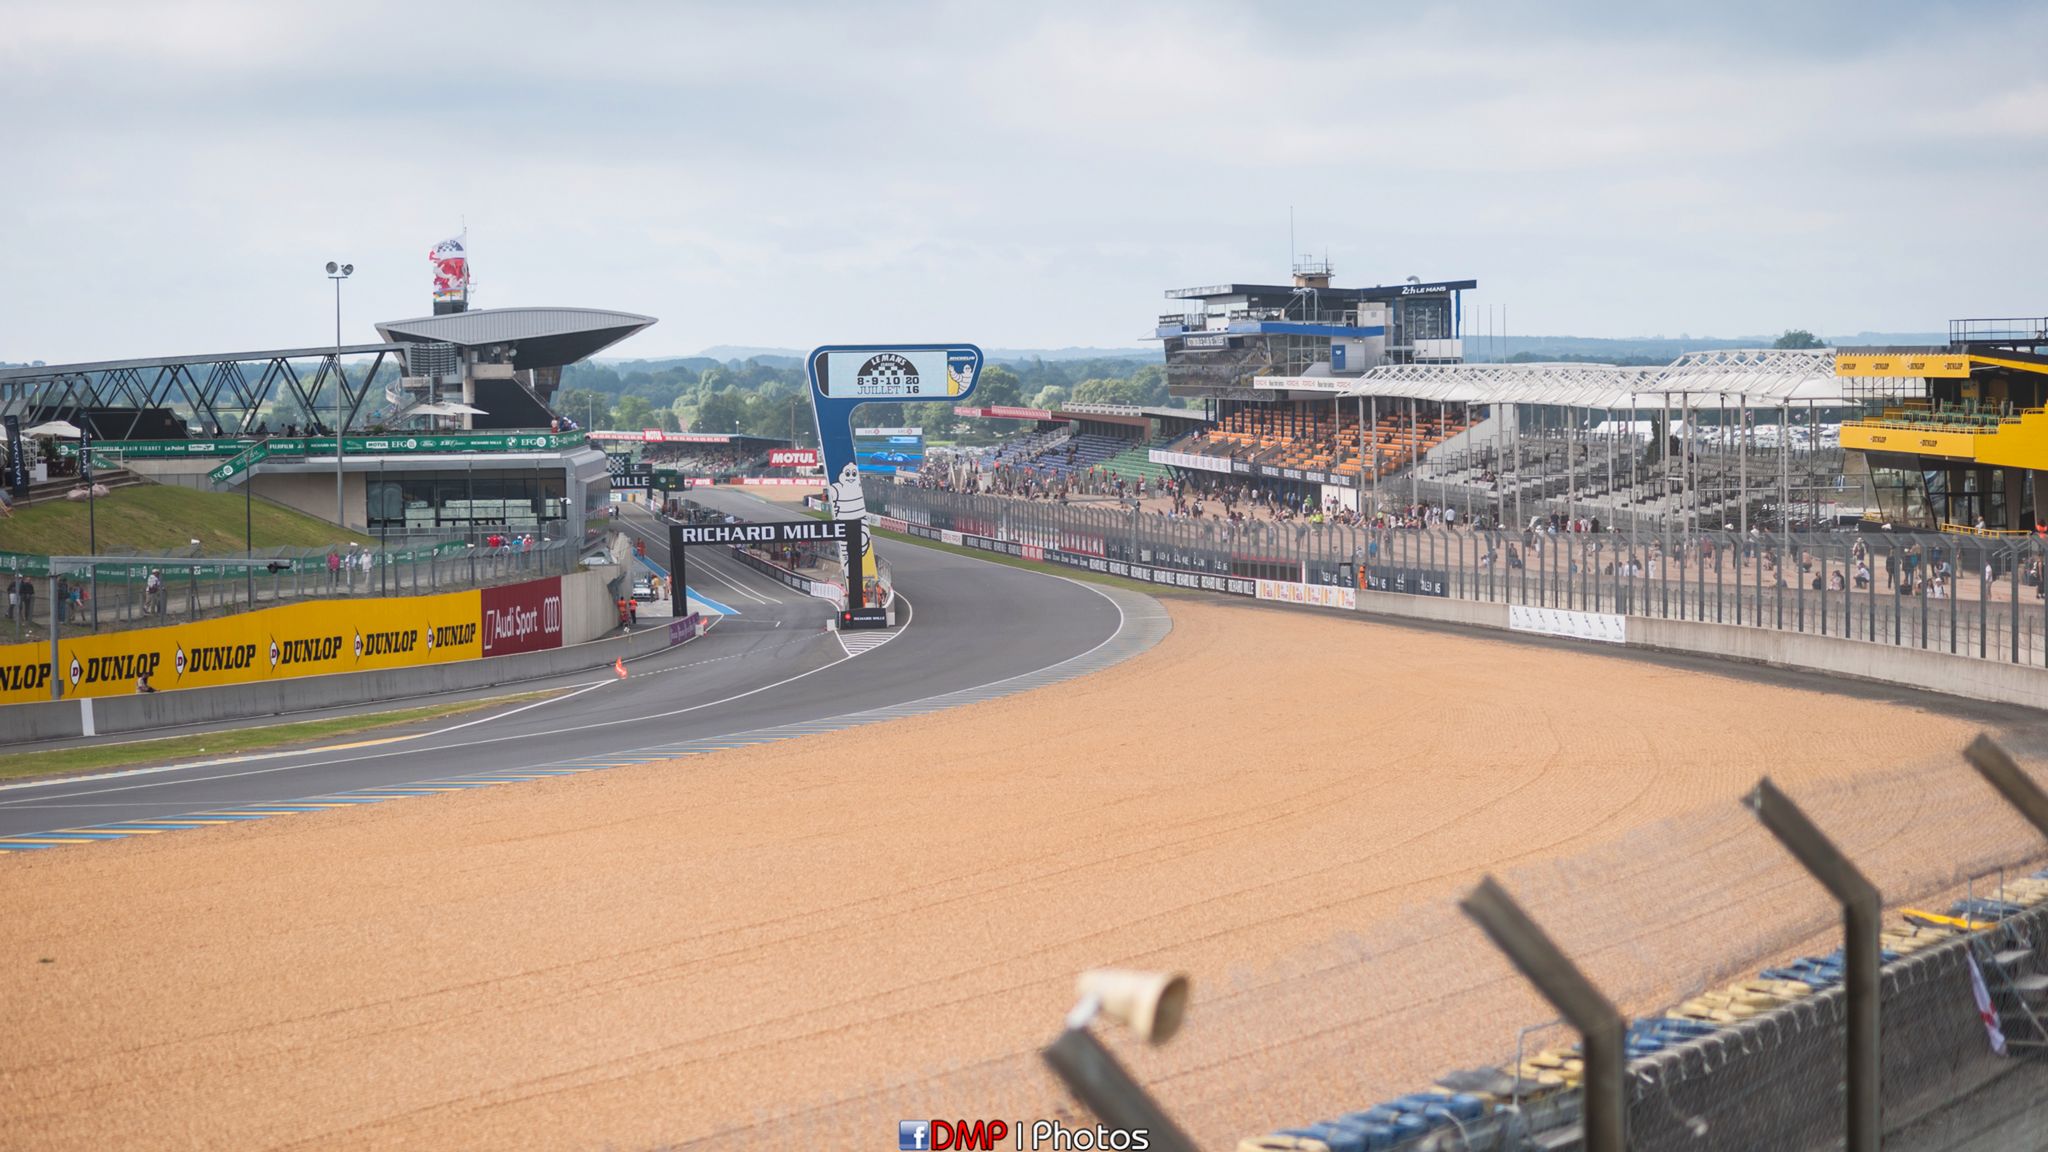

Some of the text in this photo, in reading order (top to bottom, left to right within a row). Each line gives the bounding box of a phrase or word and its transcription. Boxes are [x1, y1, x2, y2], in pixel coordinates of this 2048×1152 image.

[871, 353, 907, 366] LE MANS
[857, 385, 920, 395] JUILLET 16
[905, 376, 920, 385] 20
[391, 440, 407, 448] EFG
[521, 438, 537, 446] EFG
[771, 452, 815, 464] MOTUL
[611, 476, 650, 487] MILLE
[682, 523, 847, 543] RICHARD MILLE
[495, 605, 538, 643] Audi Sport
[364, 629, 418, 656] DUNLOP
[436, 622, 476, 648] DUNLOP
[188, 644, 257, 673] DUNLOP
[281, 636, 343, 665] DUNLOP
[85, 652, 161, 684] DUNLOP
